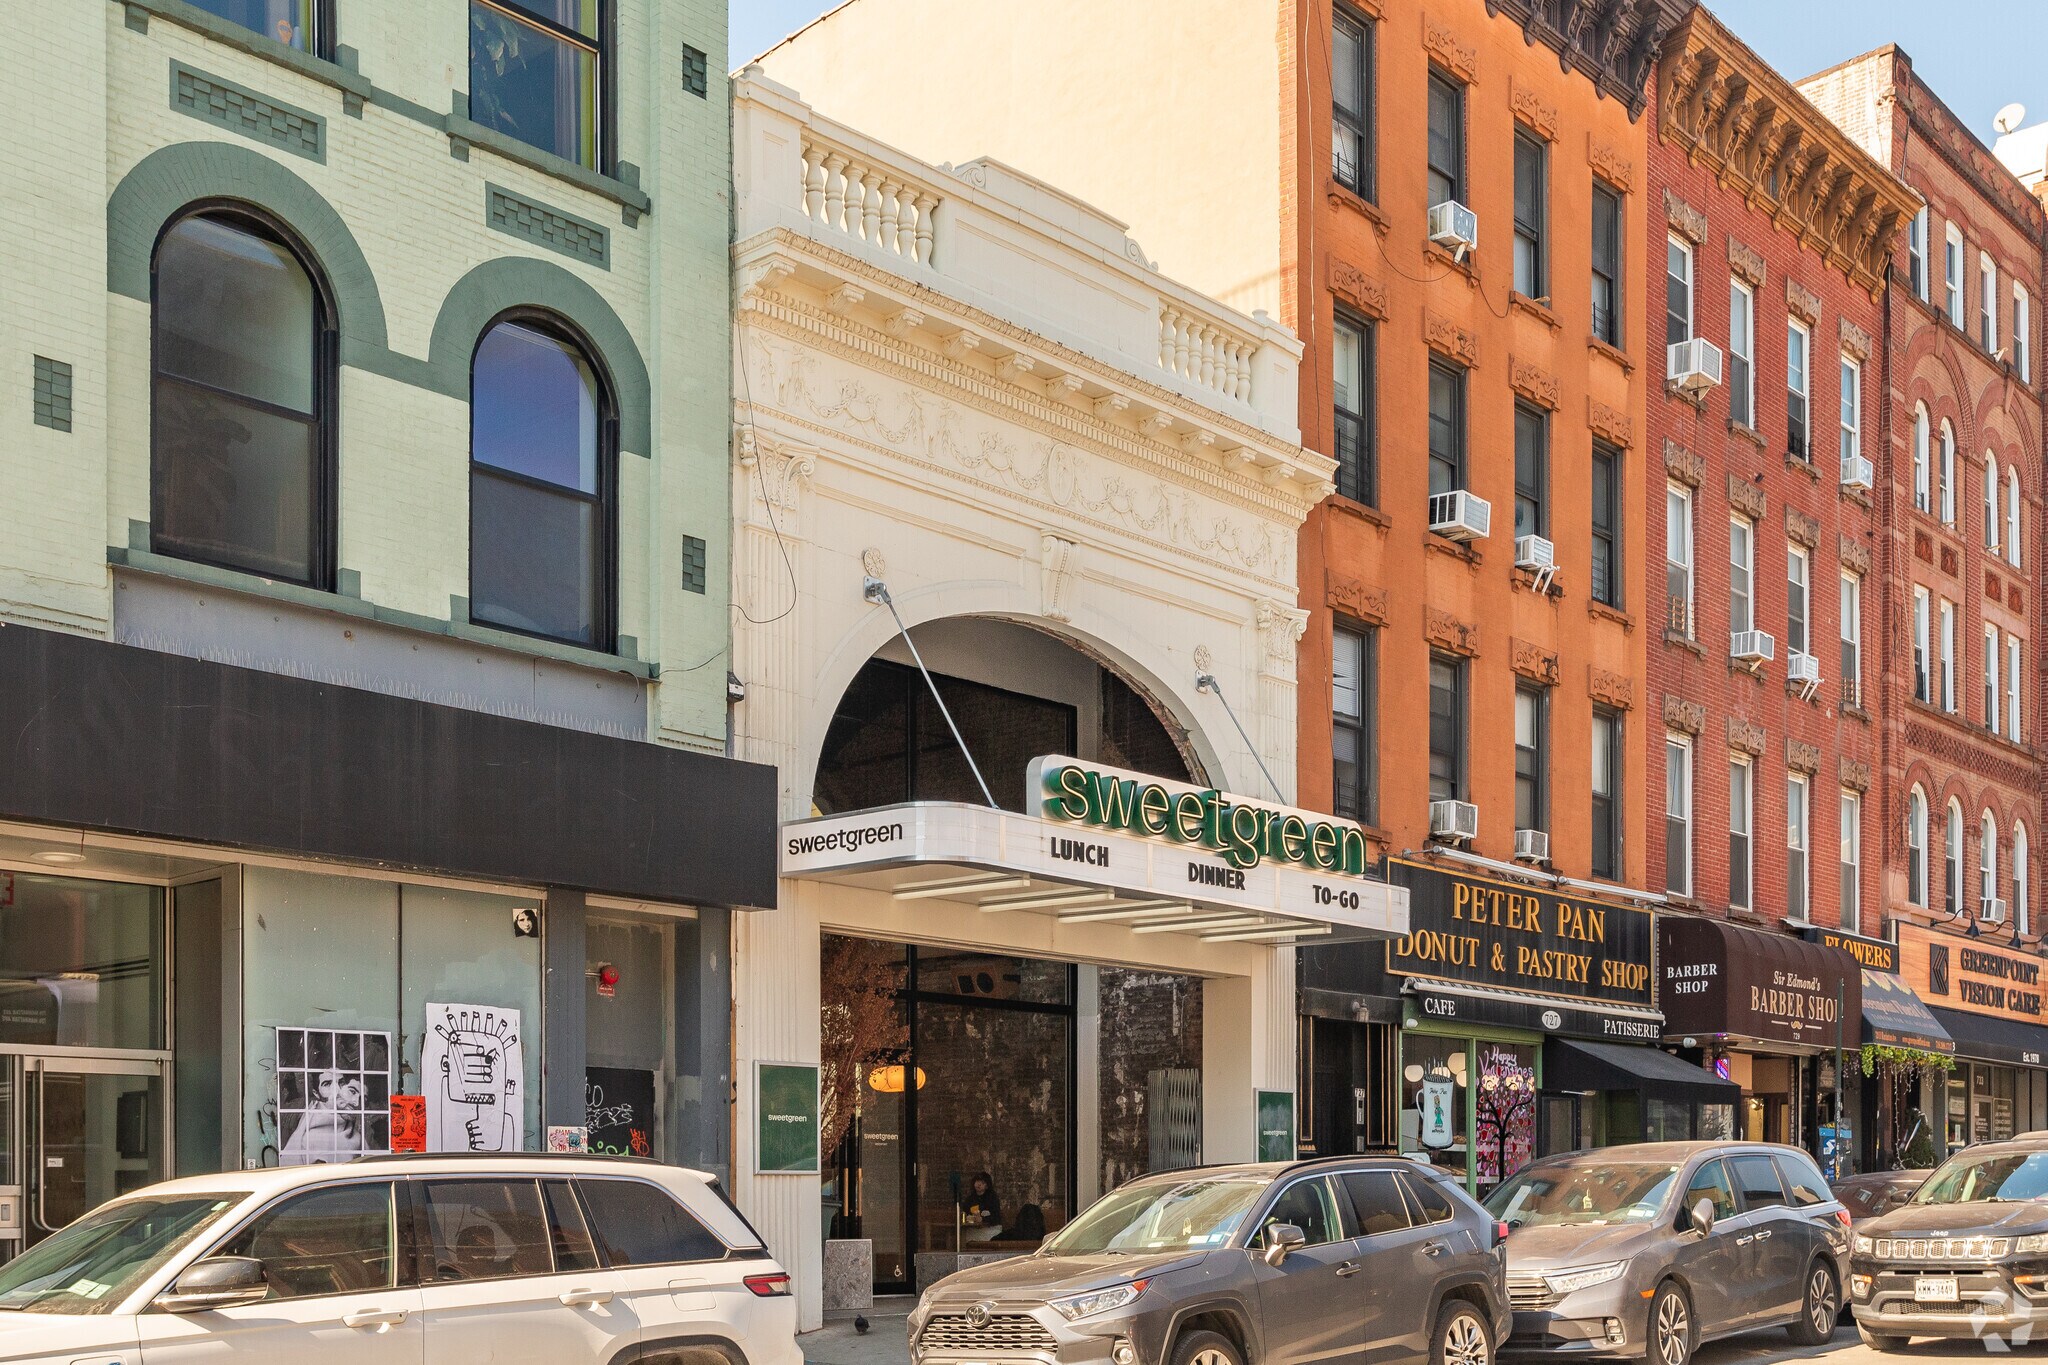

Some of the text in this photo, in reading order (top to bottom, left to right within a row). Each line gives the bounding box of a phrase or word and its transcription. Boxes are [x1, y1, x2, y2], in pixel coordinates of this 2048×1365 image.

[1043, 765, 1367, 874] sweetgreen
[788, 823, 903, 855] sweetgreen
[1051, 837, 1109, 867] LUNCH
[1188, 862, 1246, 890] DINNER
[1313, 884, 1360, 910] TO-GO
[1452, 882, 1606, 944] PETER PAN
[1396, 929, 1649, 991] DONUT & PASTRY SHOP
[1667, 963, 1718, 979] BARBER
[1960, 947, 2039, 986] GREENPOINT
[1675, 980, 1709, 994] SHOP
[1773, 970, 1821, 992] Sir Edmond's
[1424, 997, 1456, 1017] CAFE
[1750, 985, 1805, 1019] BARBER
[1959, 978, 2041, 1016] VISION CARE
[1544, 1013, 1560, 1027] 727
[1604, 1019, 1660, 1039] PATISSERIE
[1793, 1032, 1801, 1040] 729
[1490, 1045, 1517, 1067] Happy
[768, 1113, 807, 1123] sweetgreen
[864, 1132, 899, 1141] sweetgreen
